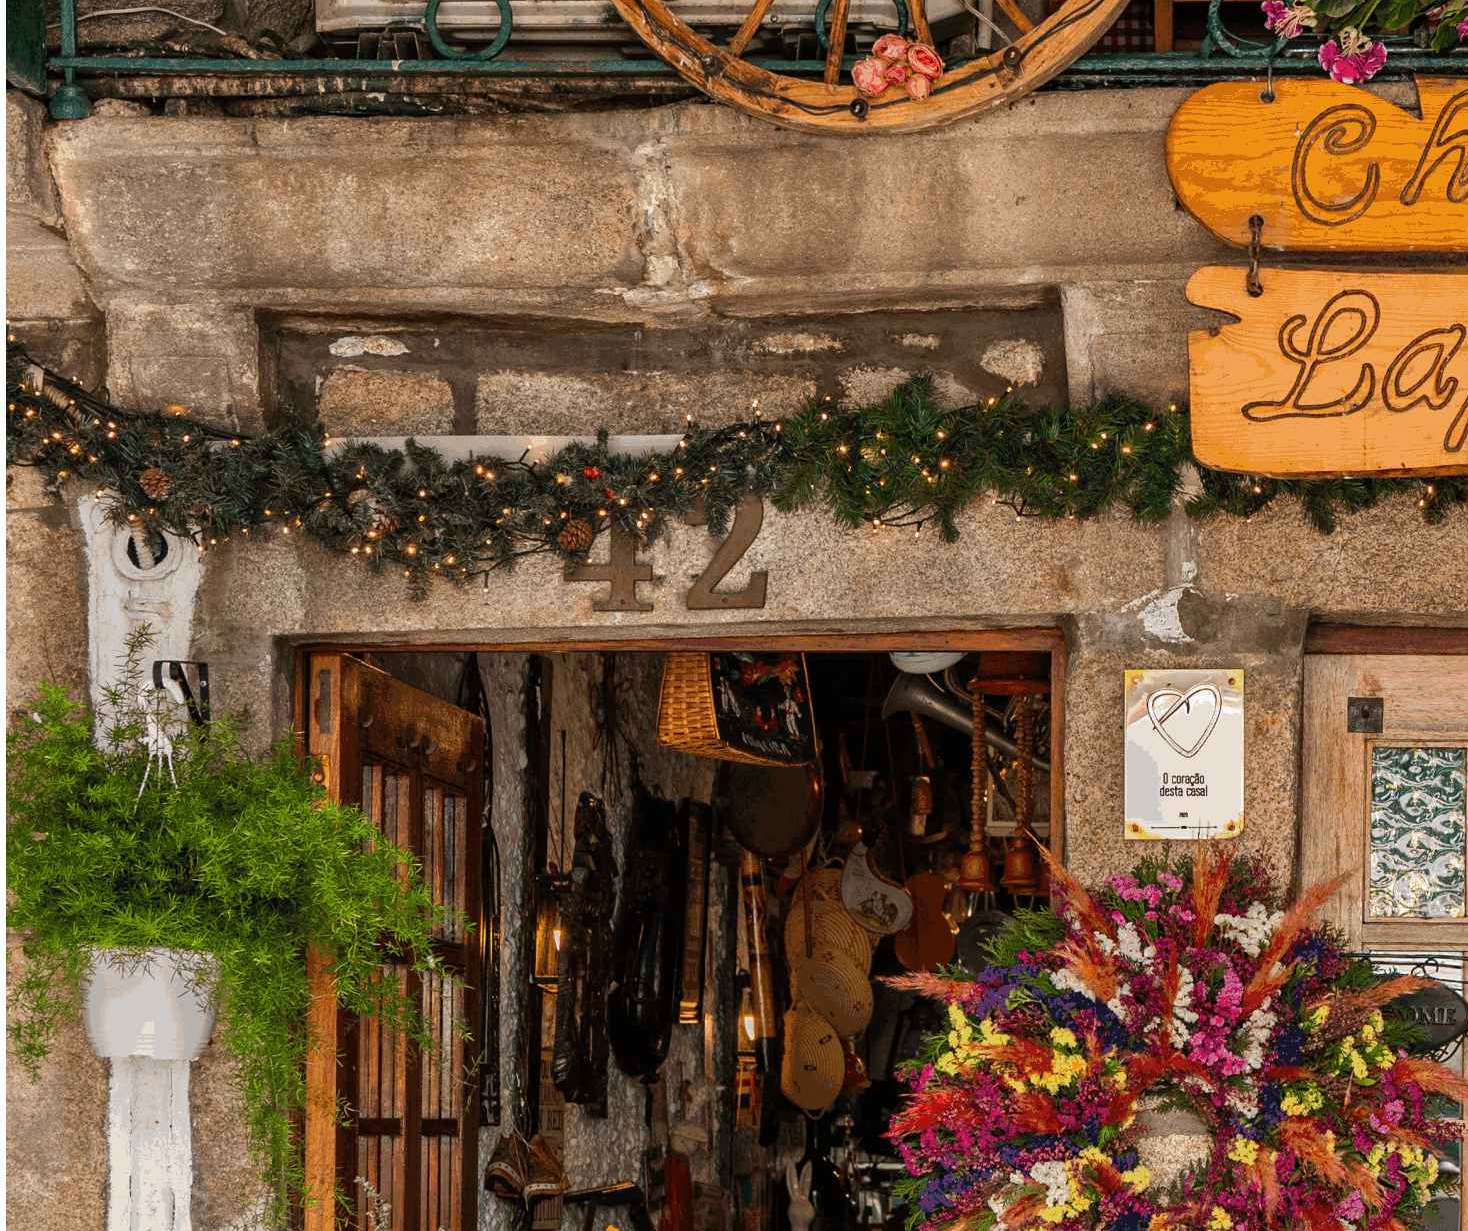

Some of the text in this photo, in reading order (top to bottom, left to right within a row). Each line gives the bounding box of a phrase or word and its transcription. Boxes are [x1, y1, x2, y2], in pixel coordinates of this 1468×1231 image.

[563, 491, 769, 611] 42
[1163, 772, 1205, 787] O coração
[1159, 785, 1184, 797] desta
